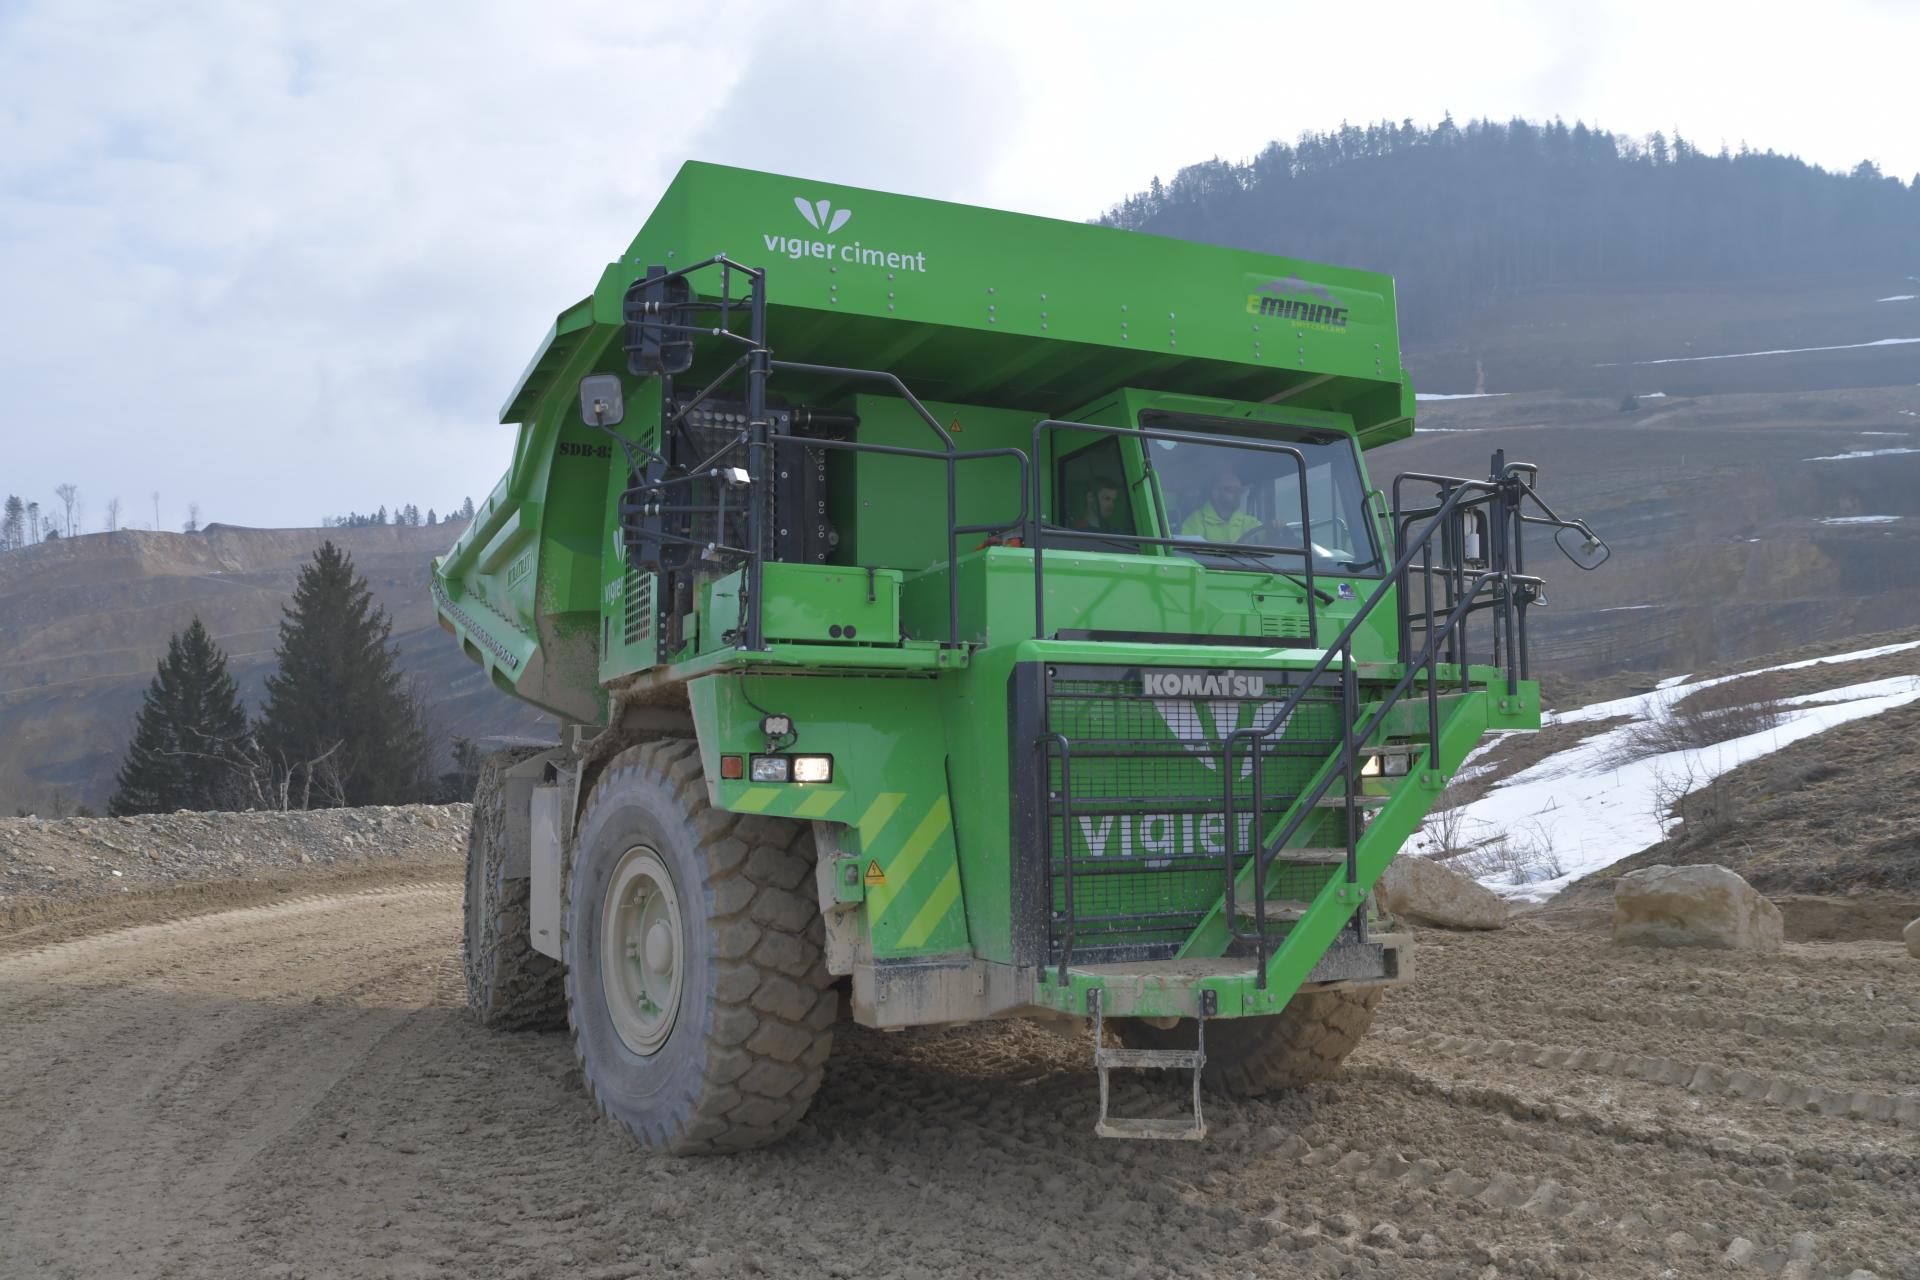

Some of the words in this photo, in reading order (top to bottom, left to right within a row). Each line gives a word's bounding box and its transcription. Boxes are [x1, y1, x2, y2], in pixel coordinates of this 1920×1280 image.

[763, 234, 836, 260] vigier
[840, 241, 926, 272] ciment
[1144, 669, 1264, 697] KOMATSU
[1078, 812, 1256, 868] vigier
